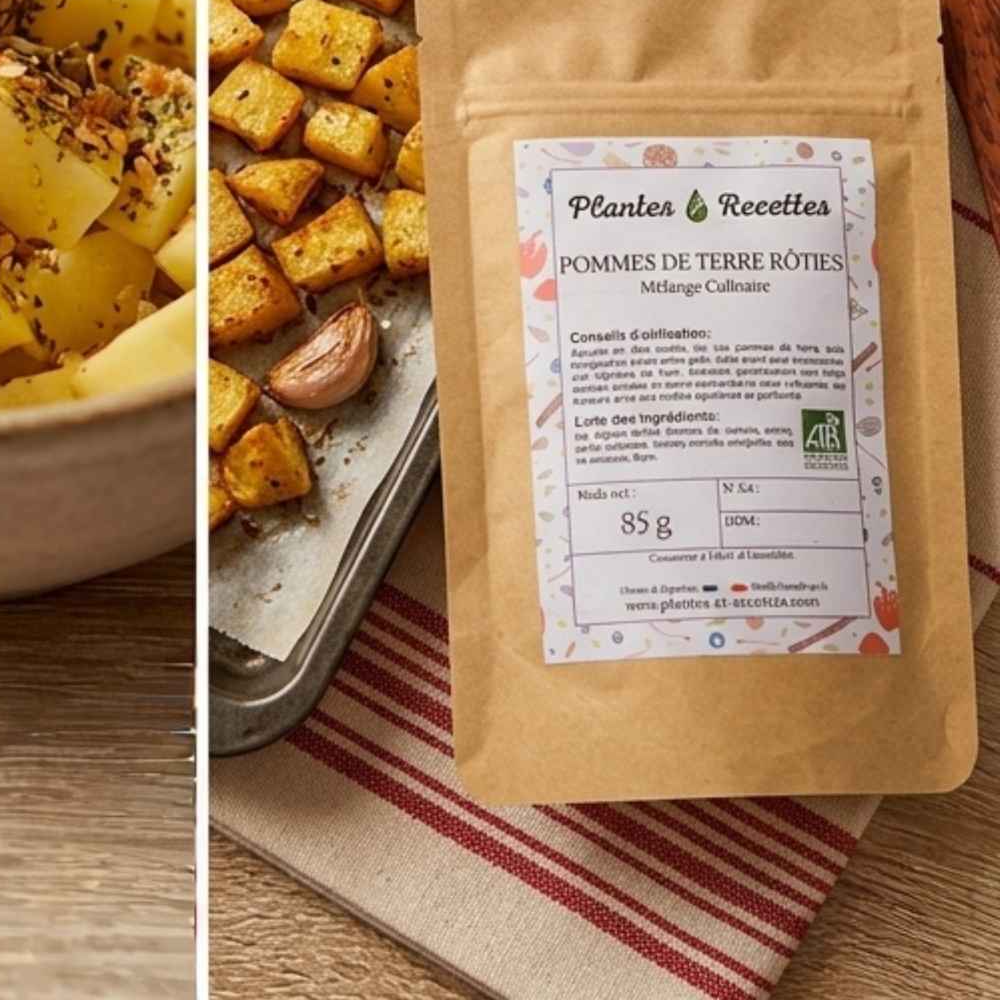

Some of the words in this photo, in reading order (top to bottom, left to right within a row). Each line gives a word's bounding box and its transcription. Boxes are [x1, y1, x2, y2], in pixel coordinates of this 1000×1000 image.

[568, 193, 675, 220] Plantes
[718, 193, 831, 219] Recettes
[560, 254, 656, 274] POMMES
[662, 254, 691, 272] DE
[696, 253, 765, 271] TERRE
[773, 248, 844, 271] RÔTIES
[620, 510, 649, 536] 85
[656, 516, 672, 539] g
